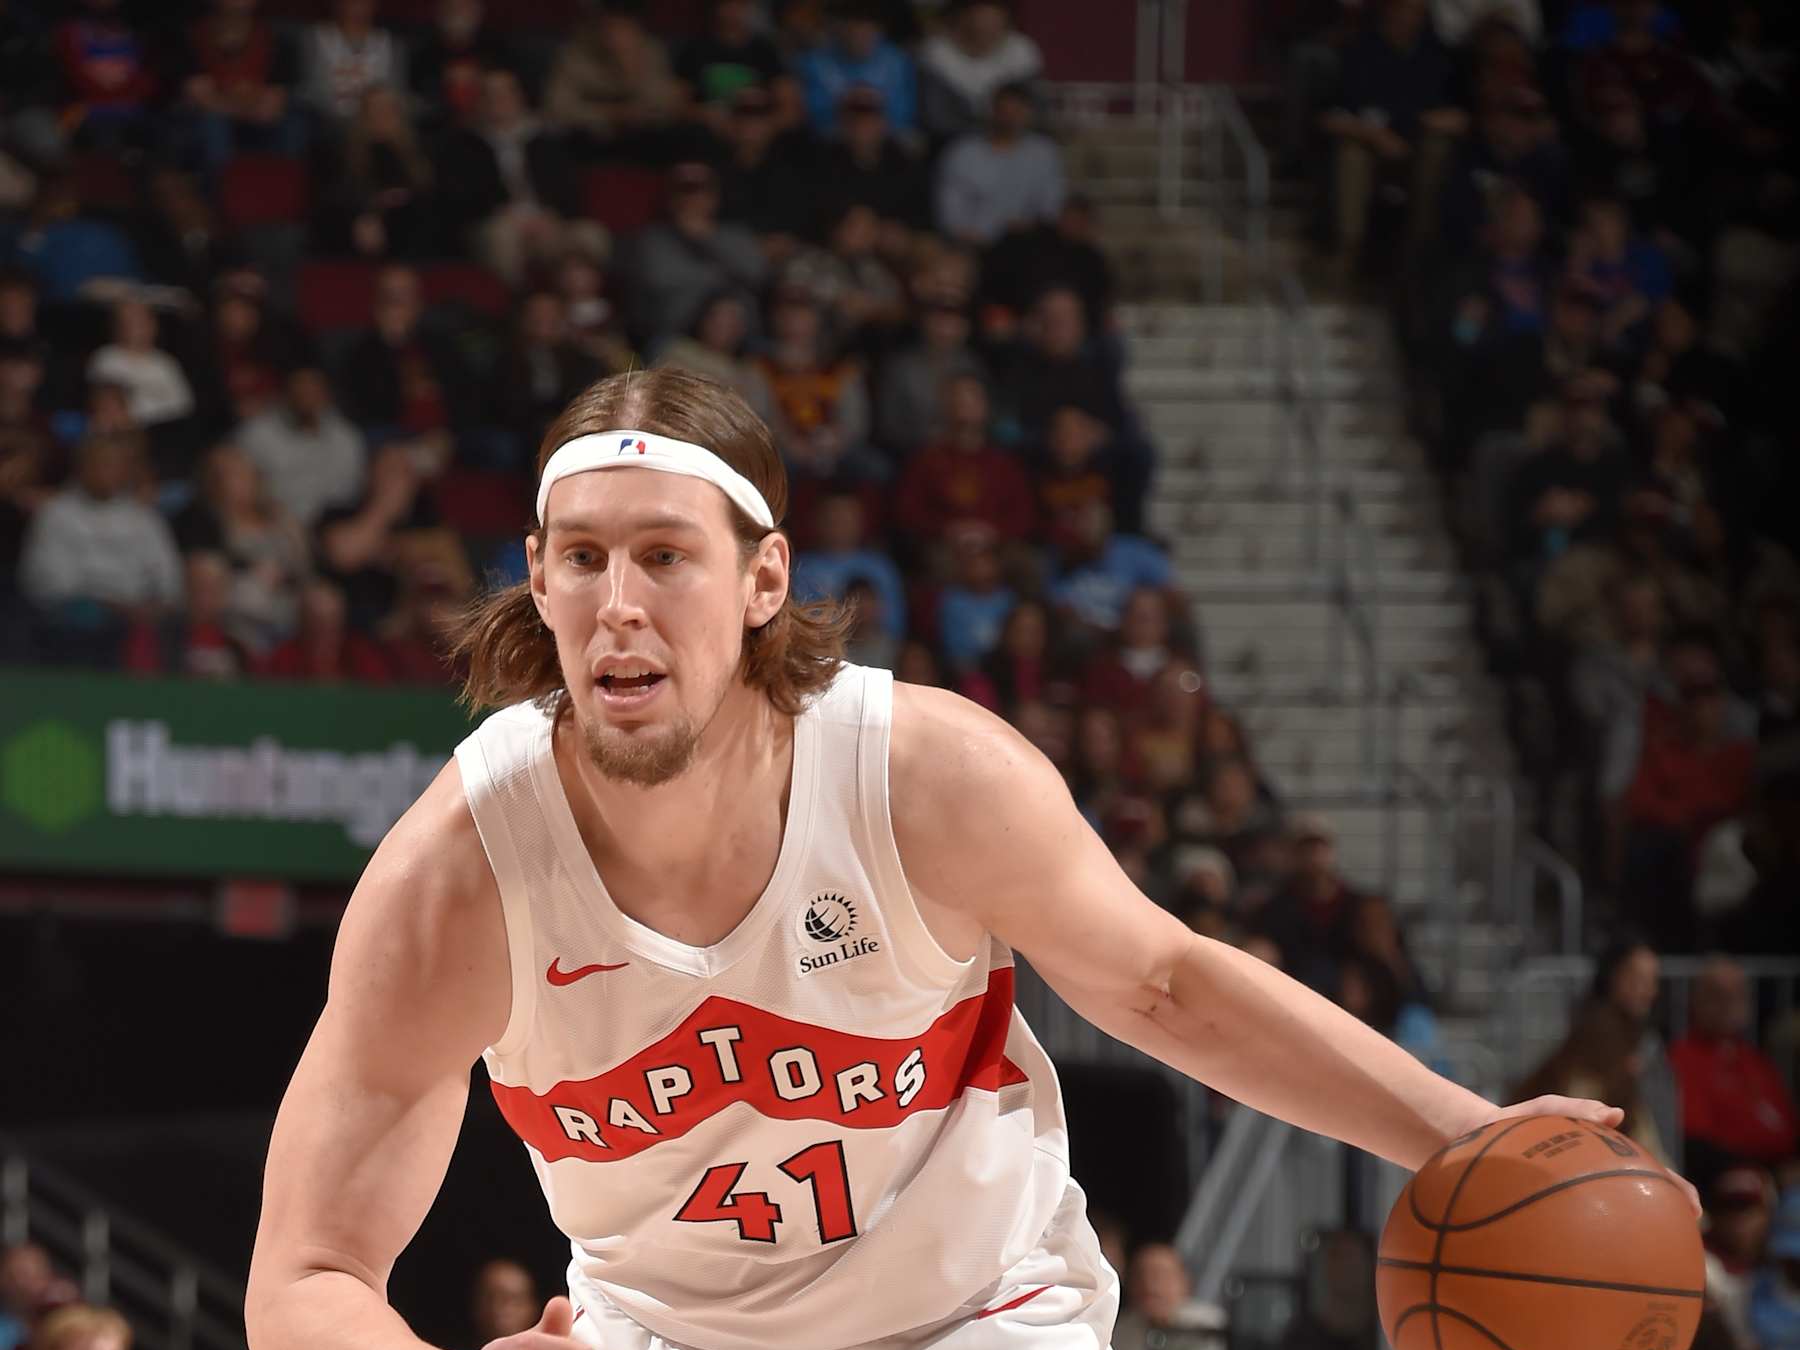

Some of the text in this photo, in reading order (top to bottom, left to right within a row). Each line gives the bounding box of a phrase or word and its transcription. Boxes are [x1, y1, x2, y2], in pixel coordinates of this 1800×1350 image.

[799, 937, 880, 974] Sun Life
[551, 1025, 927, 1150] RAPTORS
[672, 1139, 859, 1245] 41
